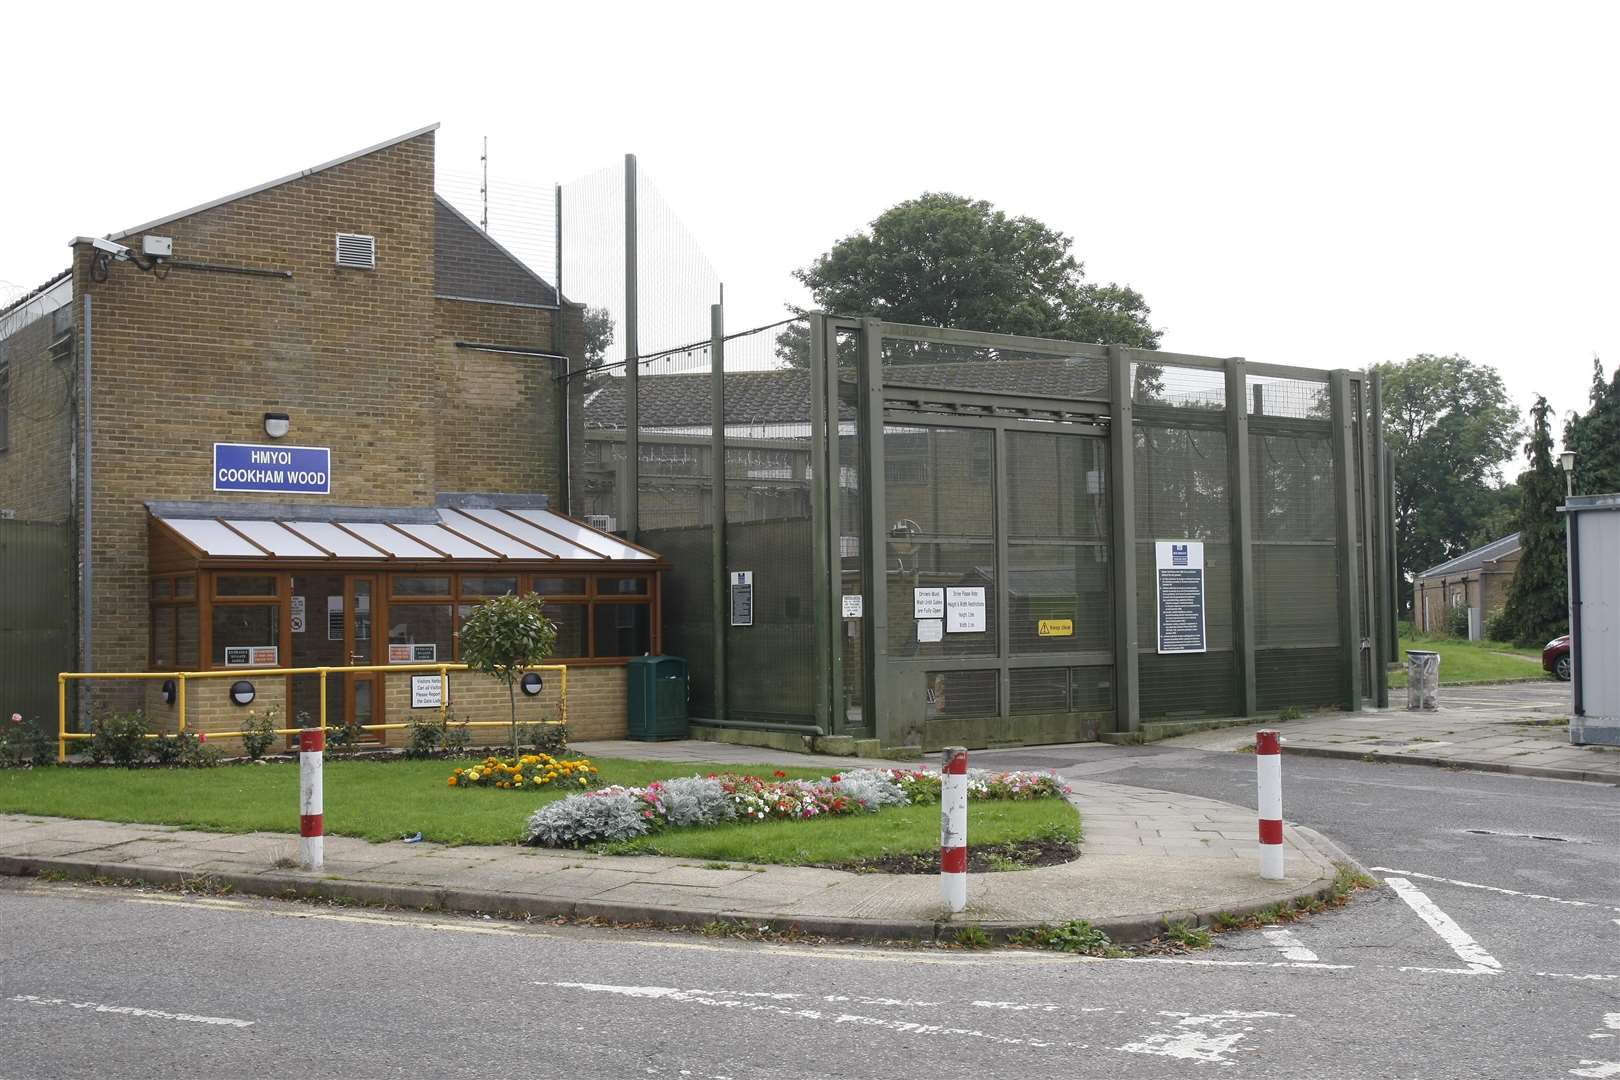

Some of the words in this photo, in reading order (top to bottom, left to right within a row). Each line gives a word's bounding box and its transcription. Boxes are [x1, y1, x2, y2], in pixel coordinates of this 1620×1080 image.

[251, 450, 291, 465] HMYOI
[219, 468, 284, 484] COOKHAM
[287, 471, 326, 485] WOOD
